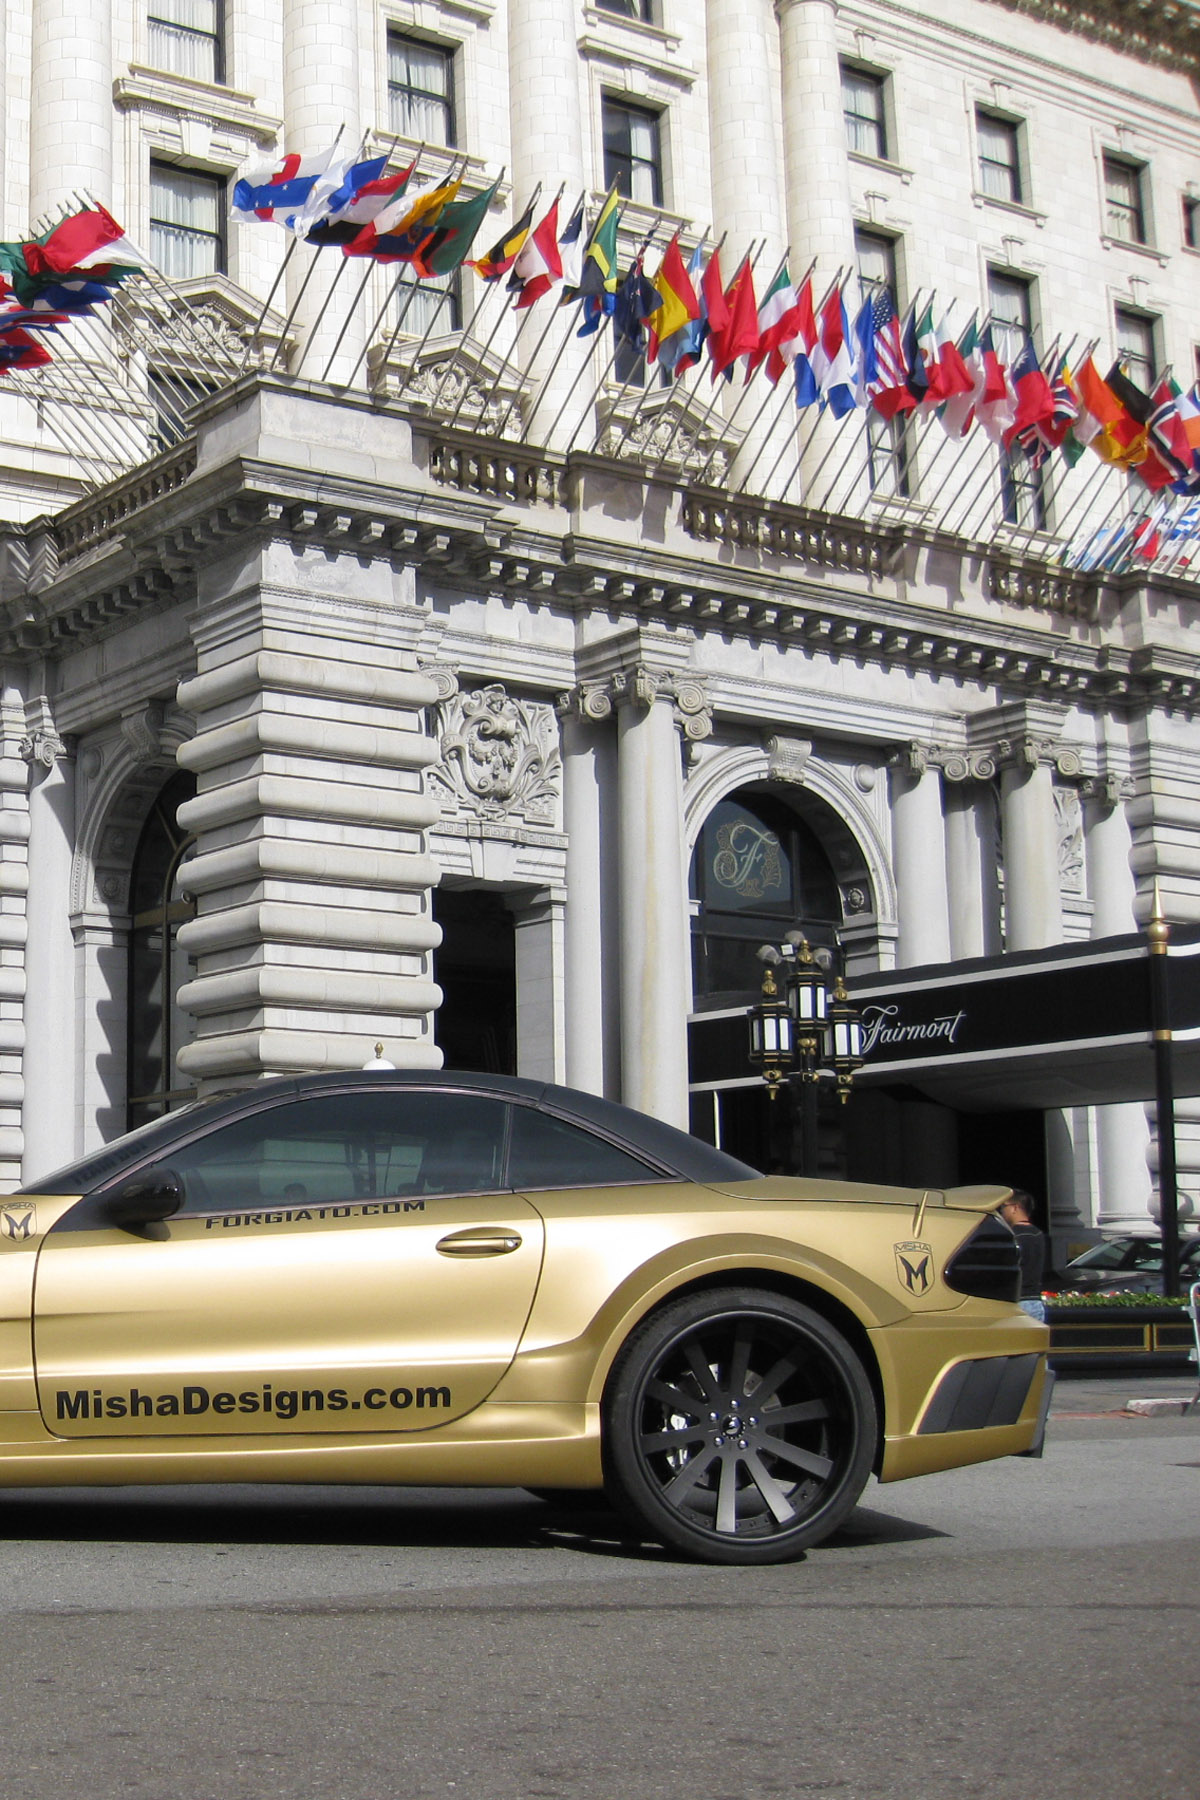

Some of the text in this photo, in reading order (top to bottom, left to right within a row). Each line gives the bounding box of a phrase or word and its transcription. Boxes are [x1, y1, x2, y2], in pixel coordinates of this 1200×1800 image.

[861, 1005, 967, 1054] Fairmont
[205, 1201, 425, 1230] FORGIATO.COM
[56, 1384, 451, 1420] MishaDesigns.com
